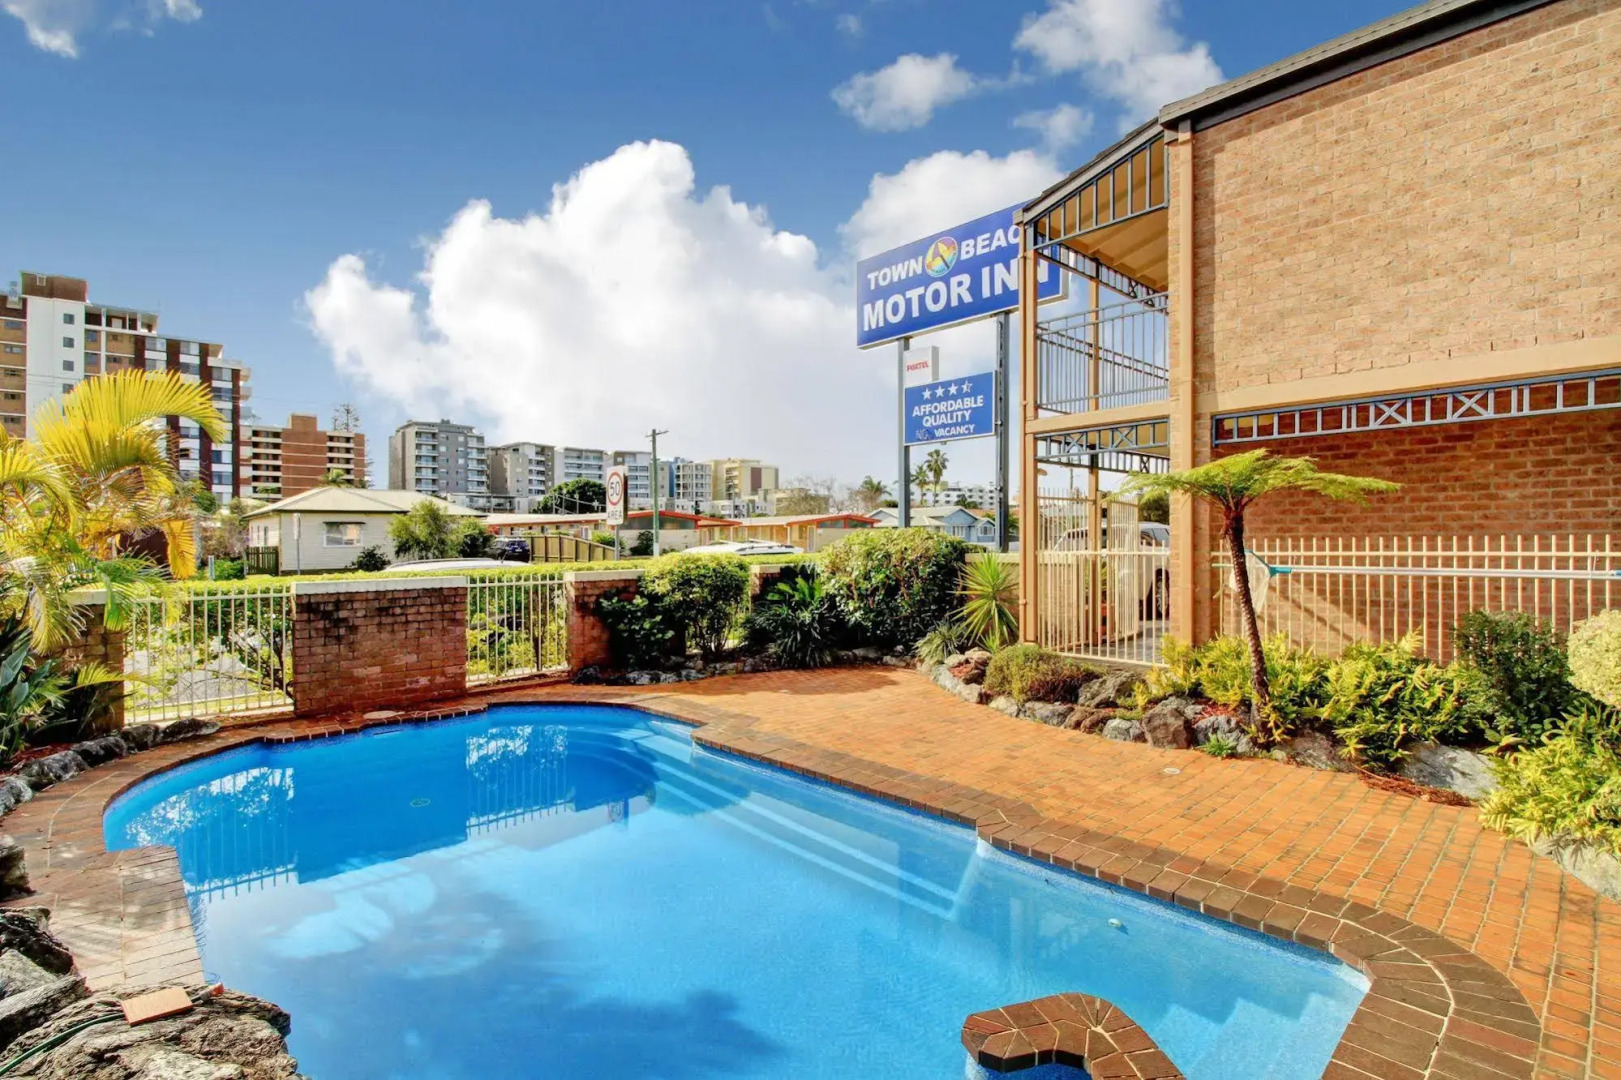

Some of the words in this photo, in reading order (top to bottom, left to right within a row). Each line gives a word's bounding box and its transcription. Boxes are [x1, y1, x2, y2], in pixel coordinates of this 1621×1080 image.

[867, 255, 924, 290] TOWN
[960, 224, 1021, 261] BEAC
[862, 273, 973, 332] MOTOR
[912, 395, 984, 417] AFFORDABLE
[922, 410, 971, 427] QUALITY
[934, 424, 975, 437] VACANCY
[609, 481, 620, 496] 50
[607, 510, 622, 520] AREA
